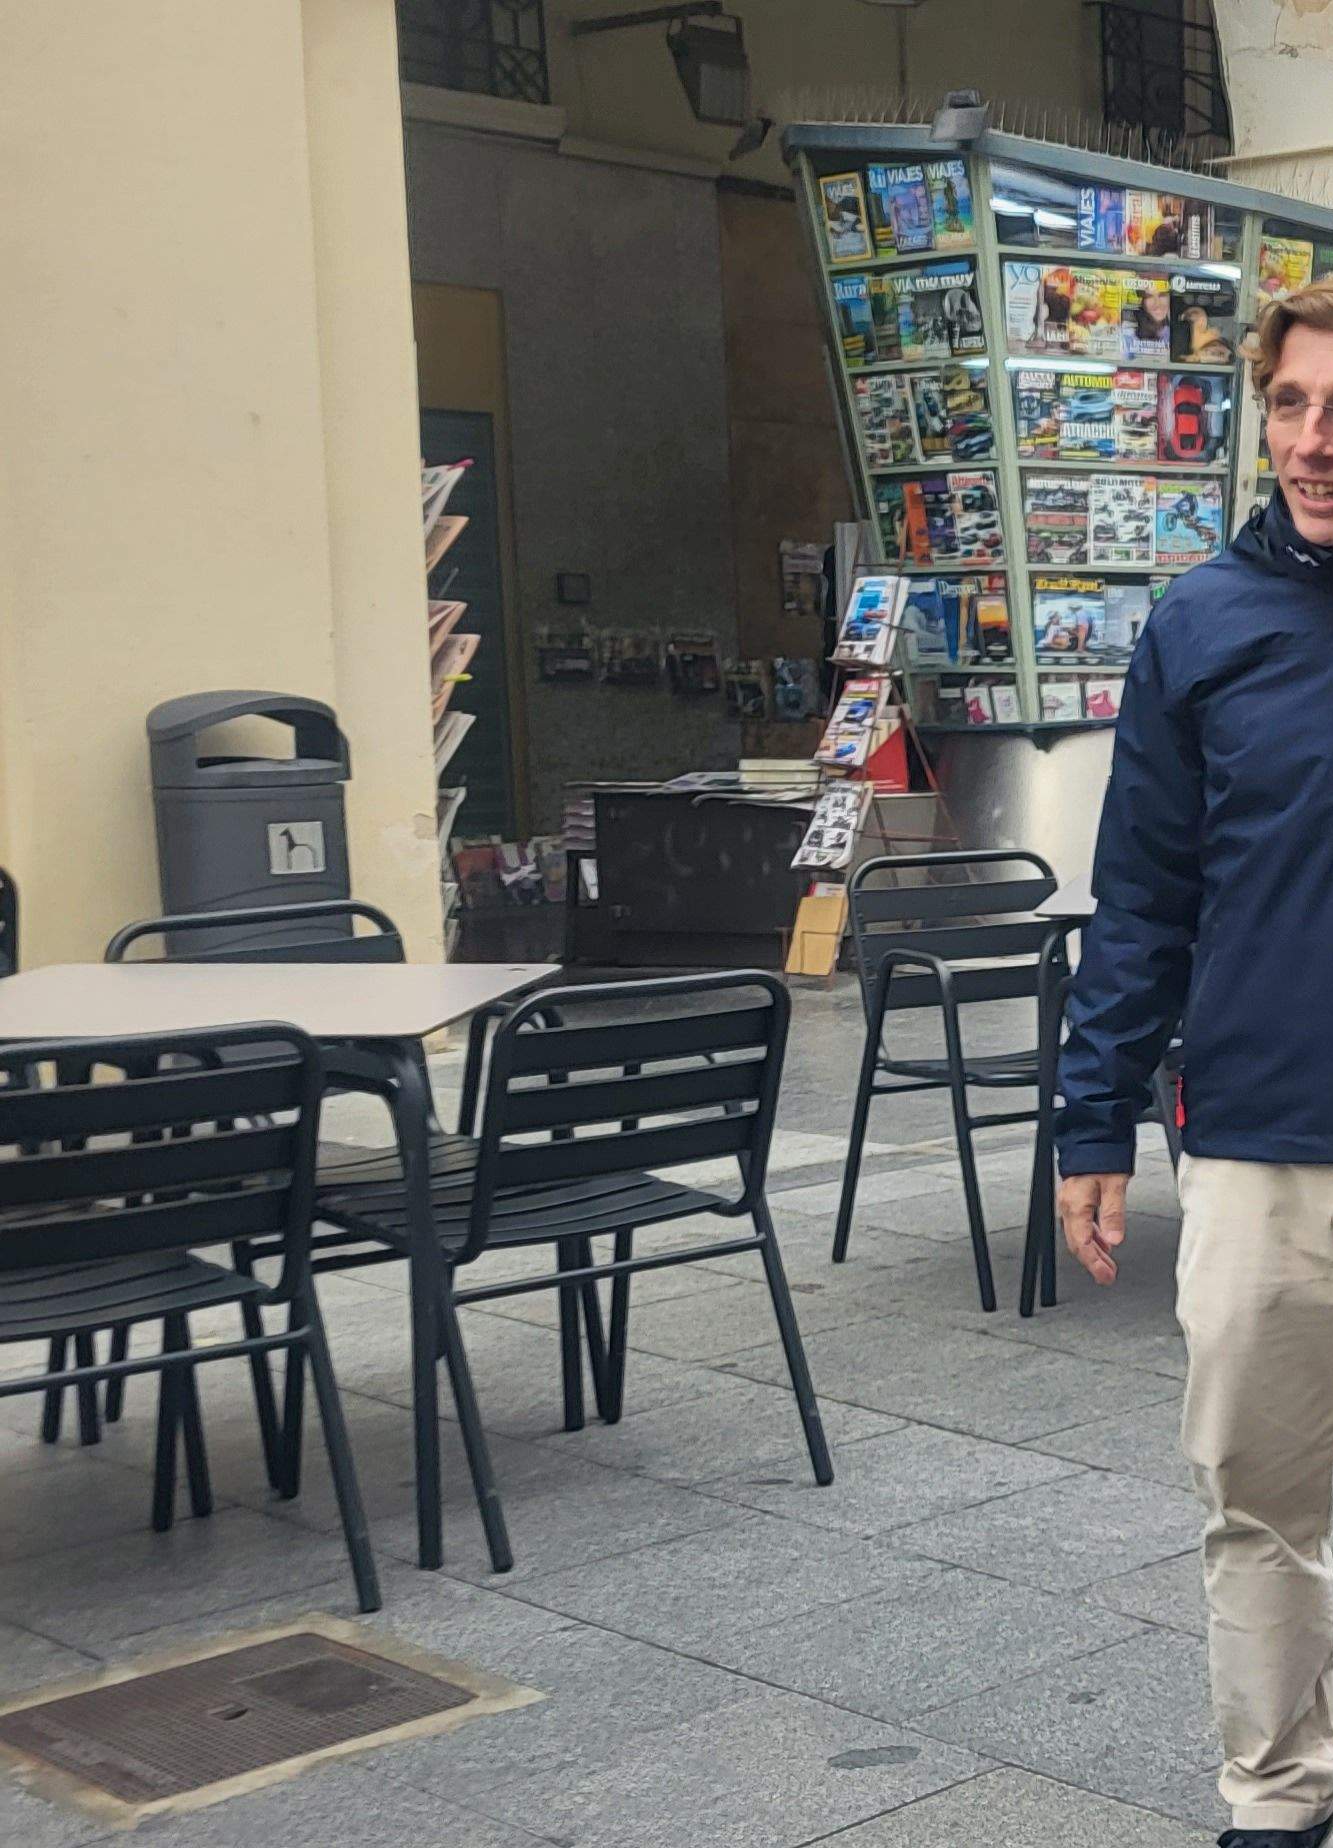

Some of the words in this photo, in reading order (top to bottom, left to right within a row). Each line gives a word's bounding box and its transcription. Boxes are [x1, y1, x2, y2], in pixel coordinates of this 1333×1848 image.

[887, 165, 923, 184] VIAJES
[928, 160, 965, 179] VIAJES
[1080, 187, 1096, 247] VIAJES
[941, 273, 975, 288] muy
